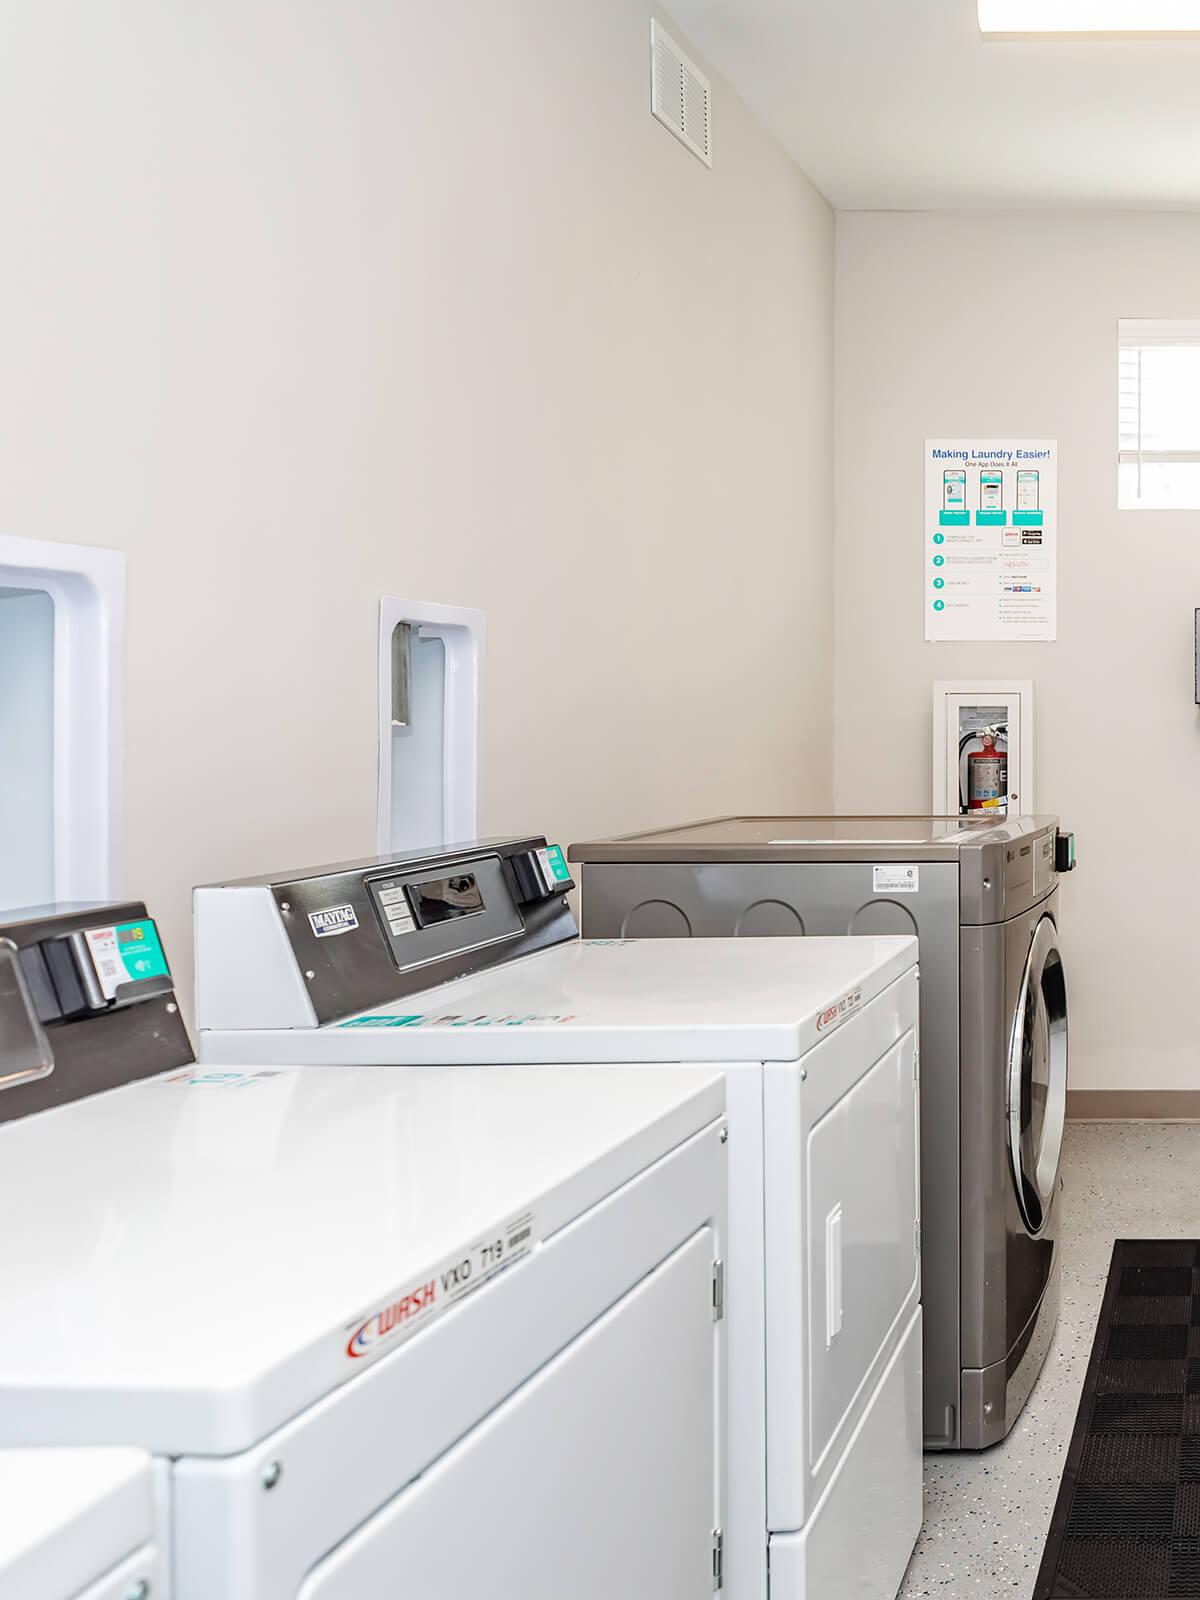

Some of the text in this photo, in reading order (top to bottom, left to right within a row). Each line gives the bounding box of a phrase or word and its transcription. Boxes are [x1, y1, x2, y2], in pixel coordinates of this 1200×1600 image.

[932, 449, 1051, 460] Making Laundry Easier!
[312, 908, 354, 929] MAYTAG
[378, 1279, 436, 1336] WASH
[480, 1239, 504, 1269] 719
